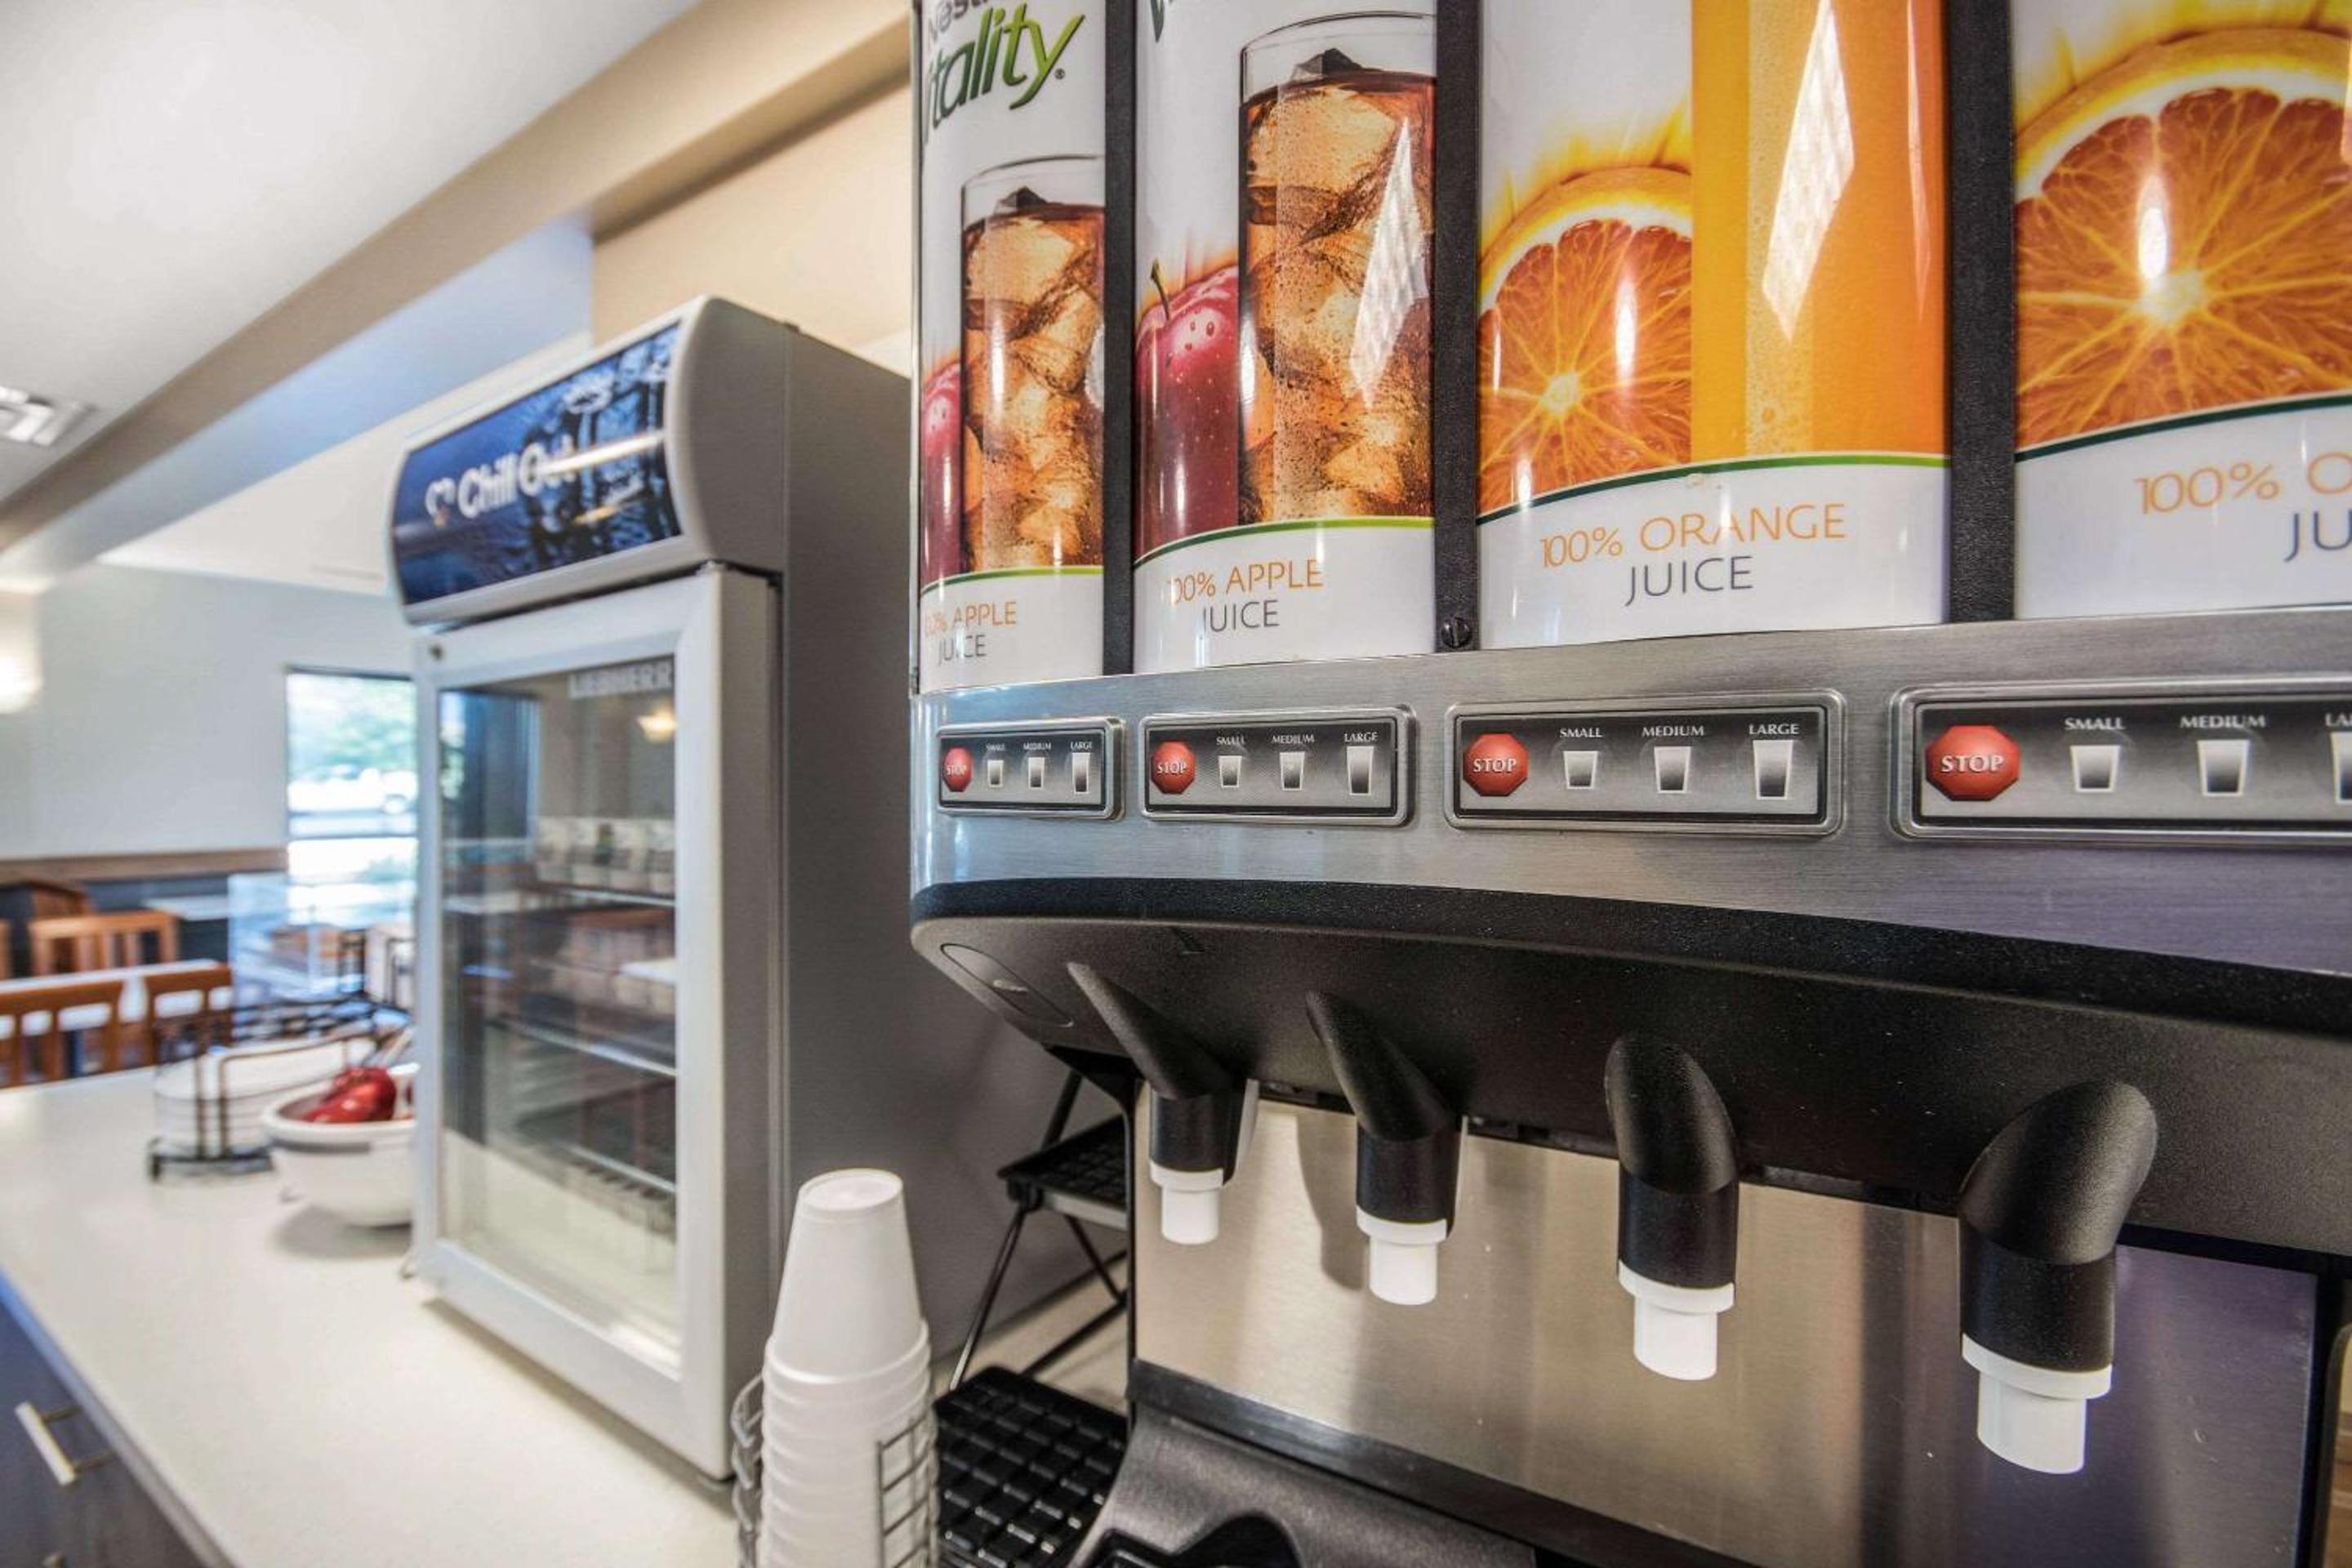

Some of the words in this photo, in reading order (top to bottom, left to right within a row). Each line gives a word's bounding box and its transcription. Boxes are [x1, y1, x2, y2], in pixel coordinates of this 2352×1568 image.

[458, 454, 519, 519] Chill
[2134, 462, 2281, 514] 100%
[1540, 527, 1624, 568] 100%
[1640, 503, 1848, 552] ORANGE
[1225, 559, 1324, 594] APPLE
[1624, 555, 1754, 607] JUICE
[953, 601, 1017, 627] APPLE
[1559, 727, 1603, 738] SMALL
[1642, 725, 1705, 737] MEDIUM
[1748, 724, 1800, 736] LARGE
[2065, 716, 2126, 731] SMALL
[2180, 715, 2266, 729] MEDIUM
[1271, 734, 1316, 744] MEDIUM
[1343, 732, 1379, 743] LARGE
[1156, 763, 1187, 775] STOP
[1472, 757, 1517, 774] STOP
[1940, 755, 2005, 773] STOP
